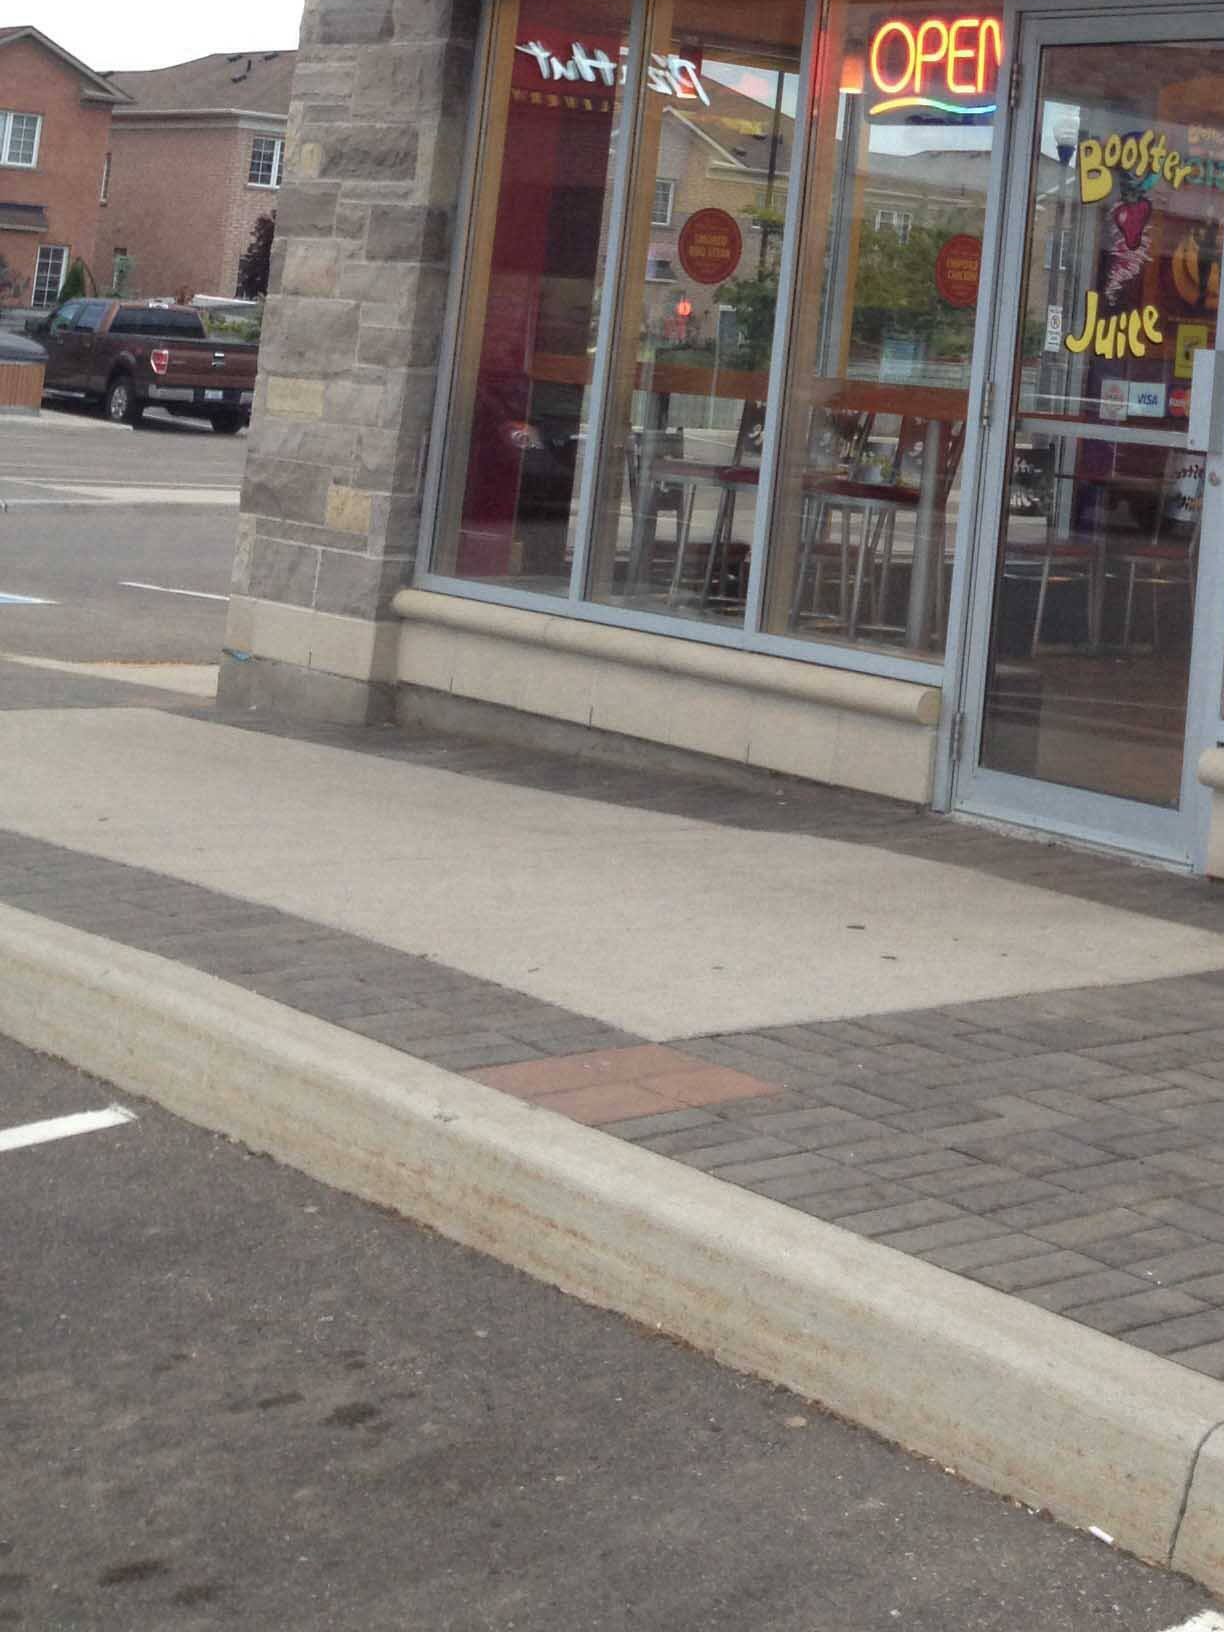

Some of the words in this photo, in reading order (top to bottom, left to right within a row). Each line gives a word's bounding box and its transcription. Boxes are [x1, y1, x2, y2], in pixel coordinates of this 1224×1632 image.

[869, 17, 1002, 94] OPEN
[1079, 129, 1193, 204] Booster
[1064, 290, 1164, 360] Juice
[1137, 392, 1159, 406] VISA
